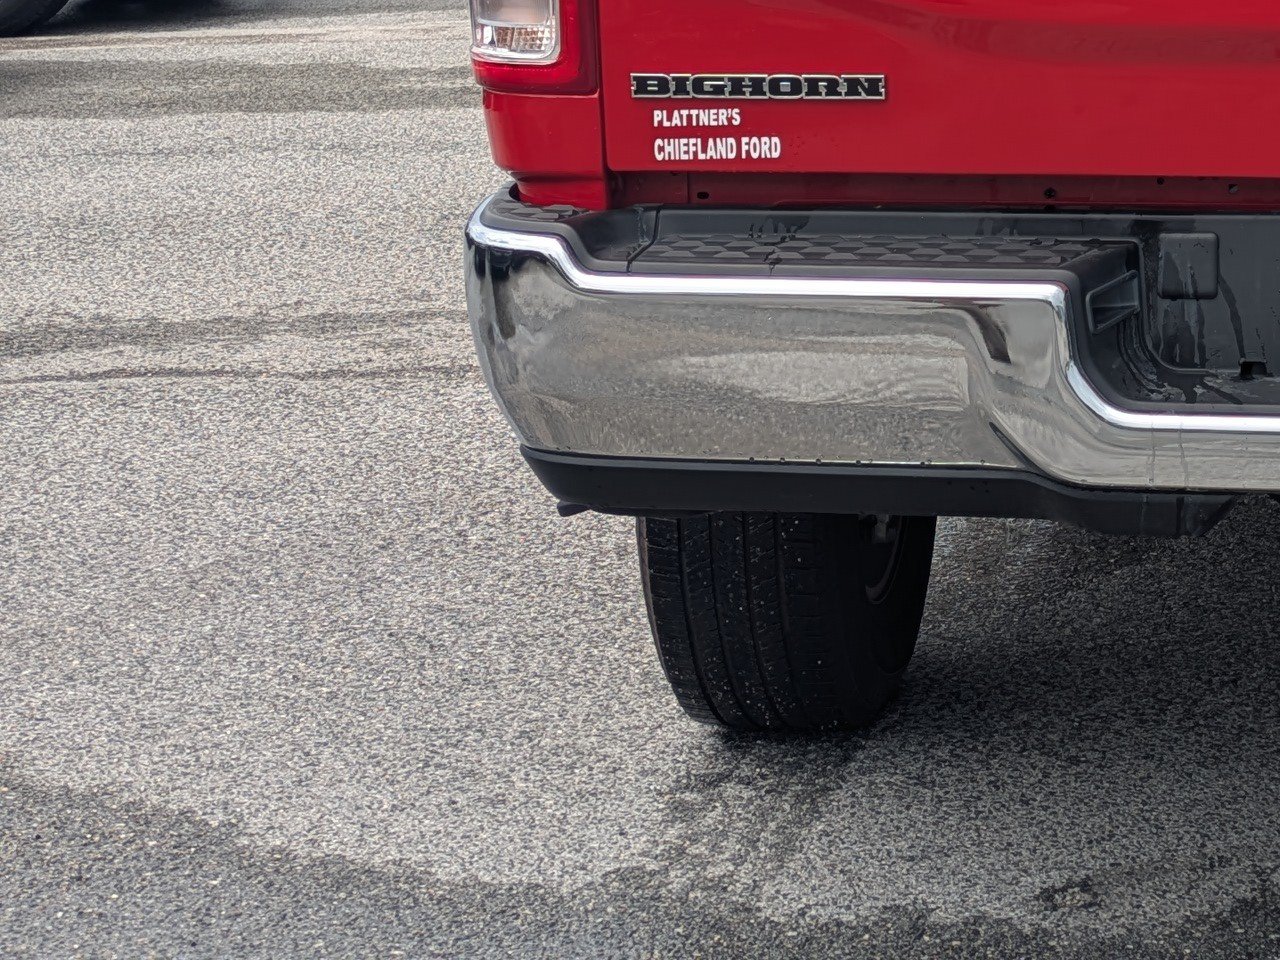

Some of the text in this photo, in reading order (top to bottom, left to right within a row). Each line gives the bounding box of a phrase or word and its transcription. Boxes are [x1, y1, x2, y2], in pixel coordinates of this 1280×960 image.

[630, 73, 885, 99] BIGHORN
[653, 108, 741, 127] PLATTNER'S
[654, 136, 781, 160] CHIEFLAND FORD
